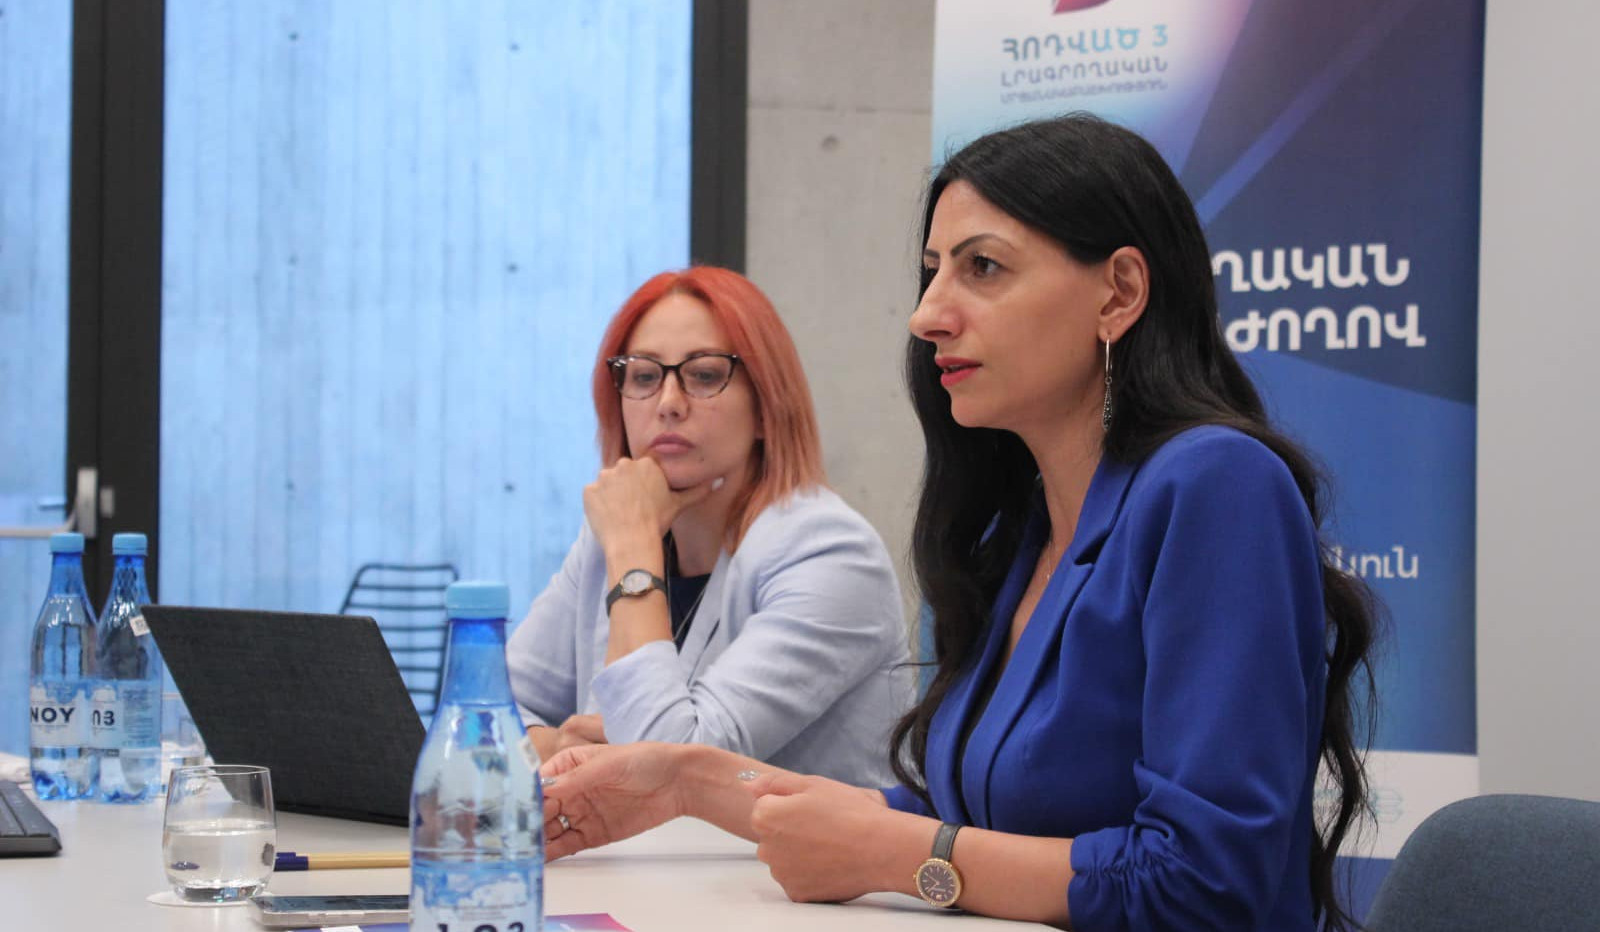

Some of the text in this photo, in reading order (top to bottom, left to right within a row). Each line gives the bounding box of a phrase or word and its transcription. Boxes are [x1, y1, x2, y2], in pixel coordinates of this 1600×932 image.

[1002, 24, 1169, 62] ՀՈԴՎԱԾ 3
[1225, 304, 1427, 353] ԺՈՂՈՎ
[30, 706, 76, 723] NOY
